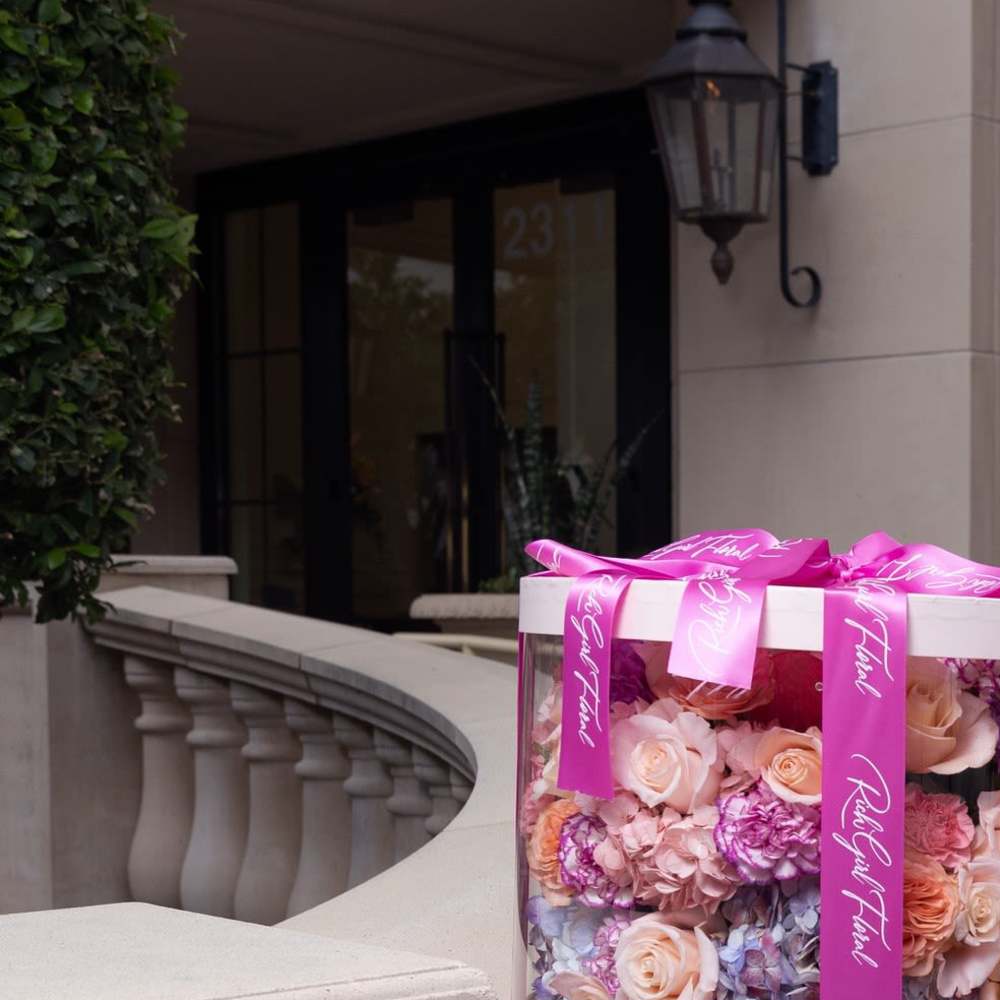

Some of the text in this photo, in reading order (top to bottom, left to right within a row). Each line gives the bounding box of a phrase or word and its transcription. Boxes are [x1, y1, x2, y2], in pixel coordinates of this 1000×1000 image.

[843, 617, 895, 698] Floral
[574, 670, 603, 748] Floral
[832, 753, 893, 969] Rich Girl Floral
